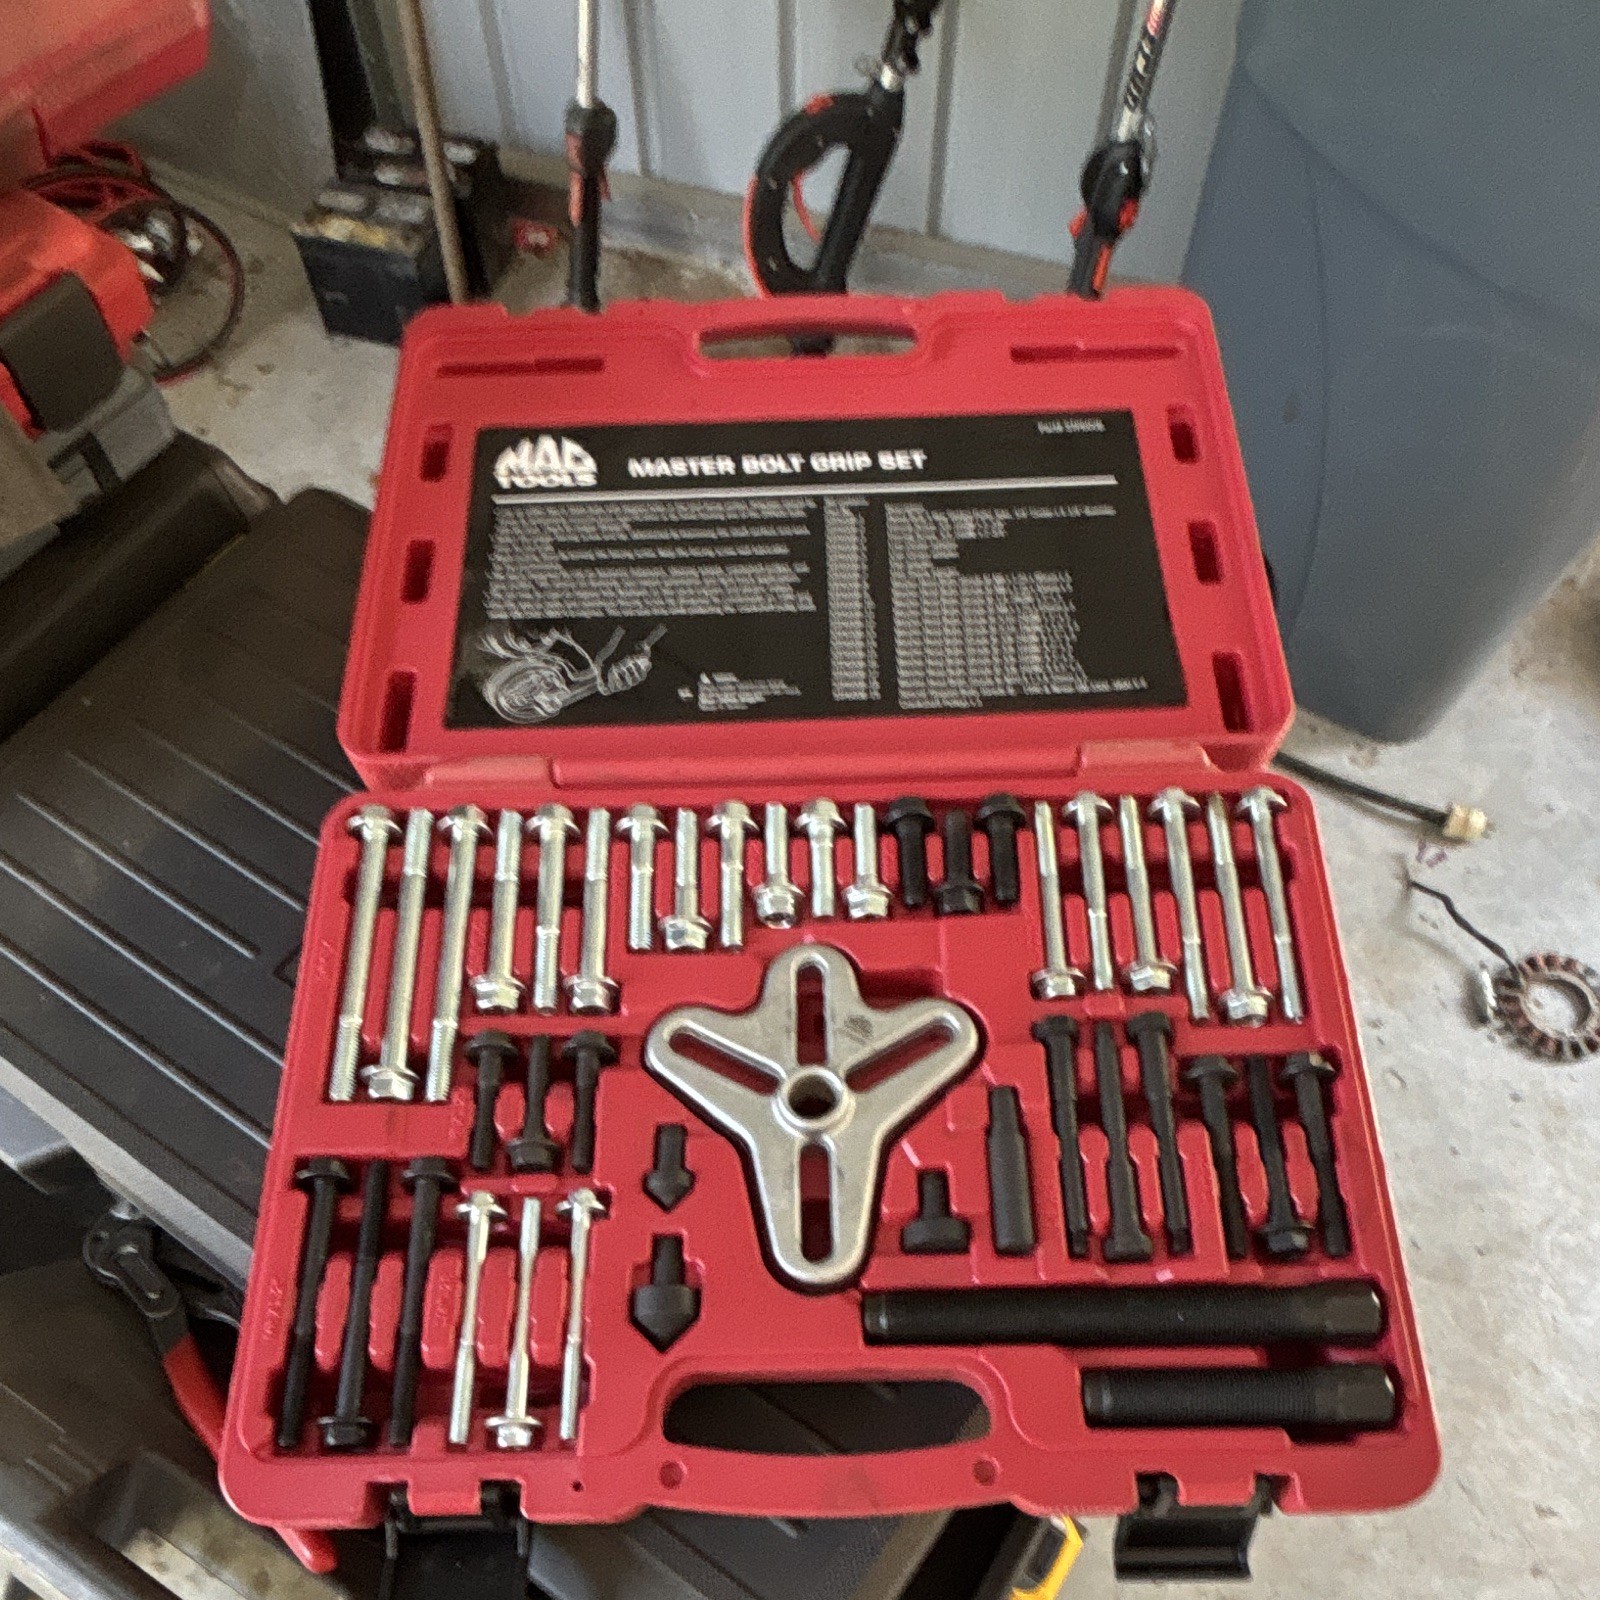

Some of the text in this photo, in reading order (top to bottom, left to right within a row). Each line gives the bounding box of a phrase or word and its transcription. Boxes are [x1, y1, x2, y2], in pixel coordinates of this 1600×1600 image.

[628, 449, 927, 478] MASTER BOLT GRIP SET
[493, 471, 598, 490] TOOLS
